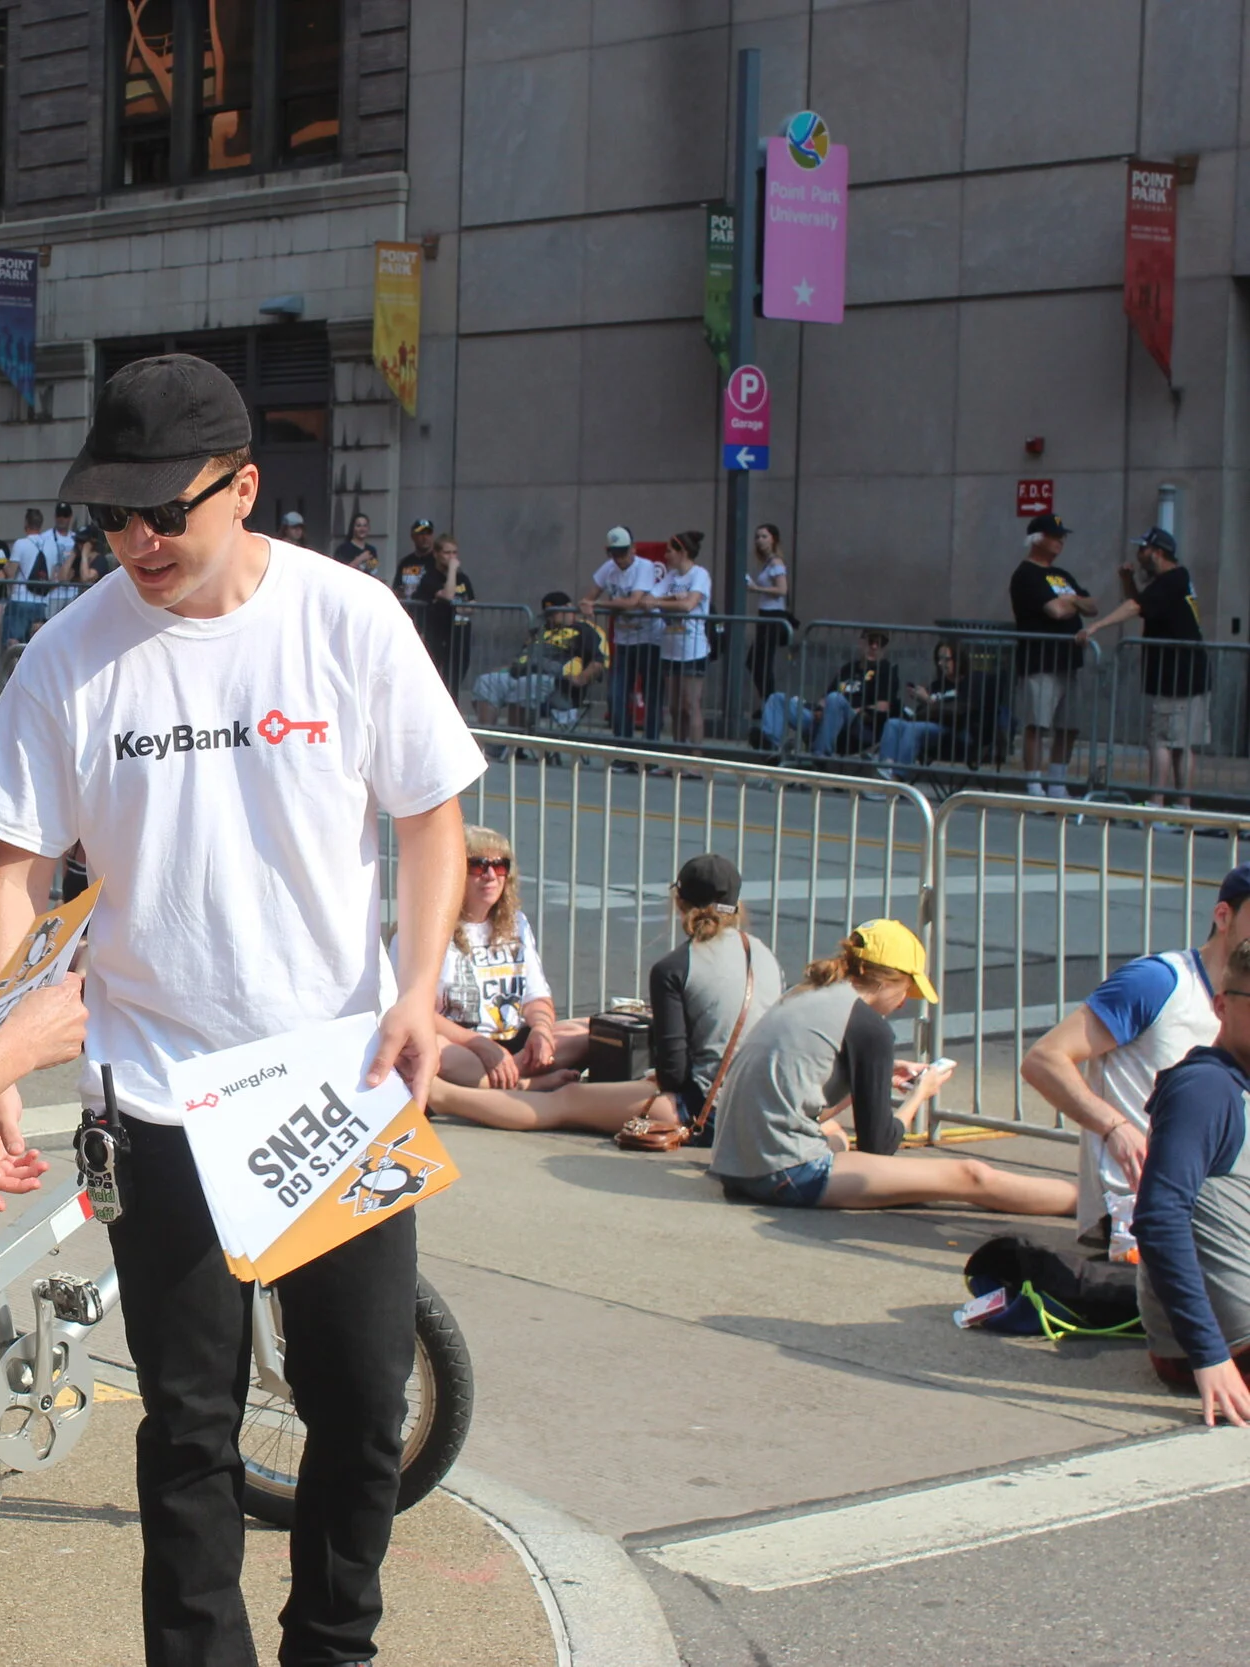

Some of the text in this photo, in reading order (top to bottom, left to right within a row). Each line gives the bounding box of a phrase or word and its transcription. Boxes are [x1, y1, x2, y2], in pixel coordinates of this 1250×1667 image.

[1132, 170, 1173, 190] POINT
[770, 181, 842, 205] Point Park
[1132, 186, 1167, 204] PARK
[710, 214, 734, 230] POI
[769, 204, 839, 232] University
[710, 229, 735, 244] PAR
[380, 249, 418, 265] POINT
[378, 262, 412, 276] PARK
[740, 373, 759, 403] P
[731, 417, 764, 431] Garage
[114, 720, 251, 761] KeyBank
[219, 1062, 289, 1098] KeyBank
[247, 1081, 353, 1190] PENS
[276, 1115, 371, 1209] LET'S GO
